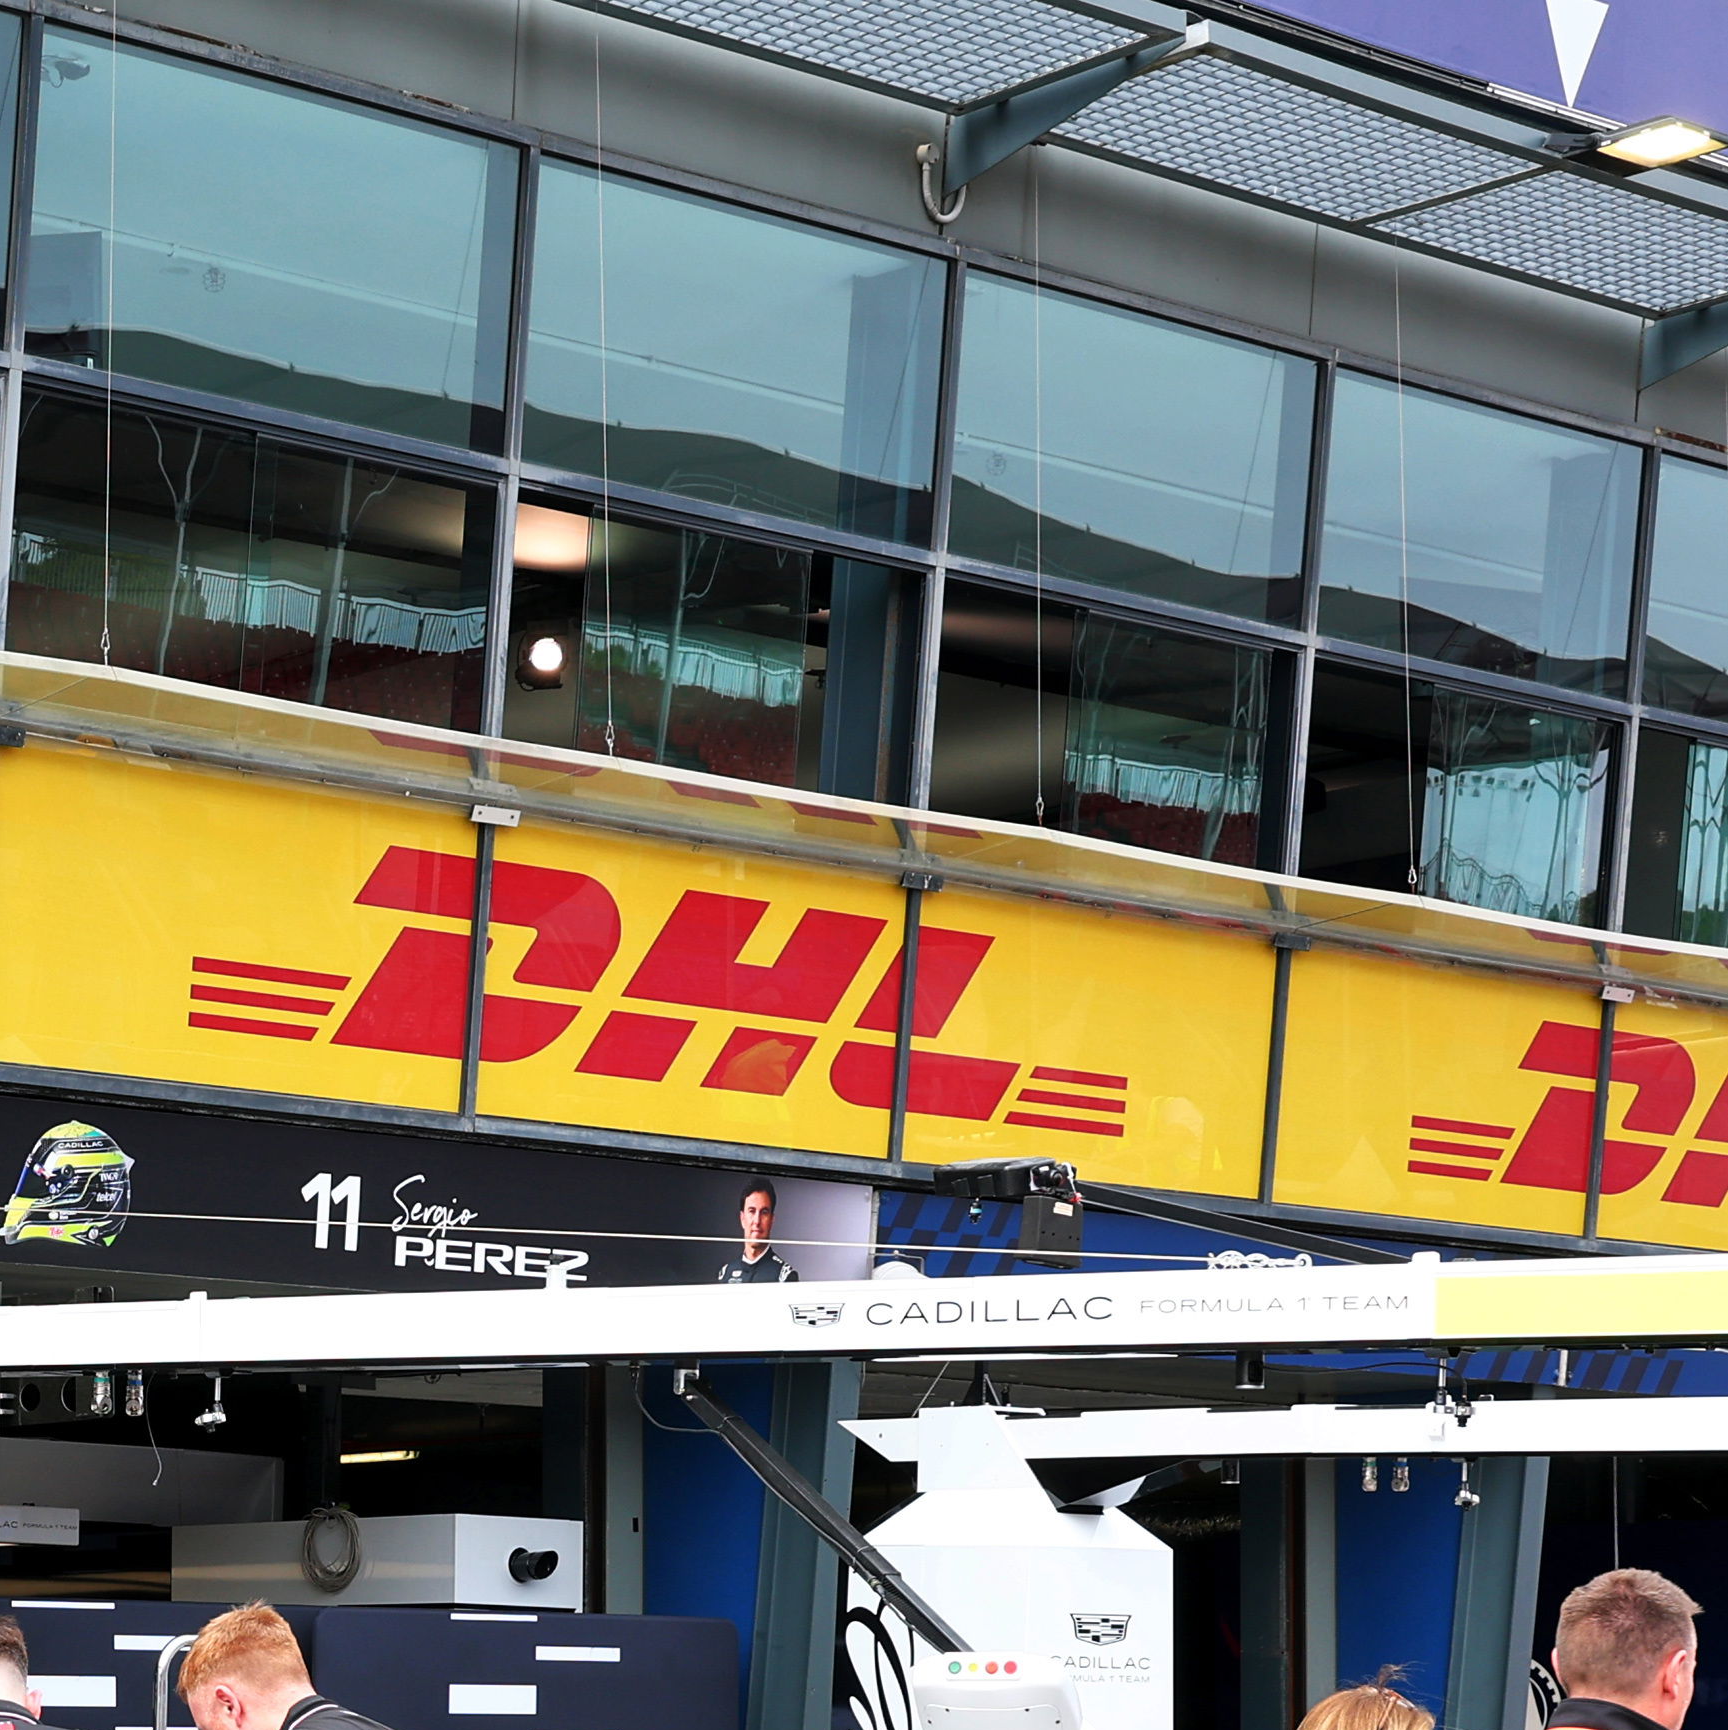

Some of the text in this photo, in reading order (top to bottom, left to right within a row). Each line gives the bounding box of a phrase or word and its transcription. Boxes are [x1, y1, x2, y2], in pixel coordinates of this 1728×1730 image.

[330, 845, 1022, 1122] DHL
[57, 1140, 104, 1150] CADILLAC
[301, 1172, 478, 1264] 11 Sergio
[394, 1234, 590, 1284] PEREZ
[866, 1296, 1114, 1327] CADILLAC
[1140, 1297, 1284, 1315] FORMULA
[1322, 1295, 1411, 1312] TEAM
[1051, 1655, 1151, 1670] ADILLAC
